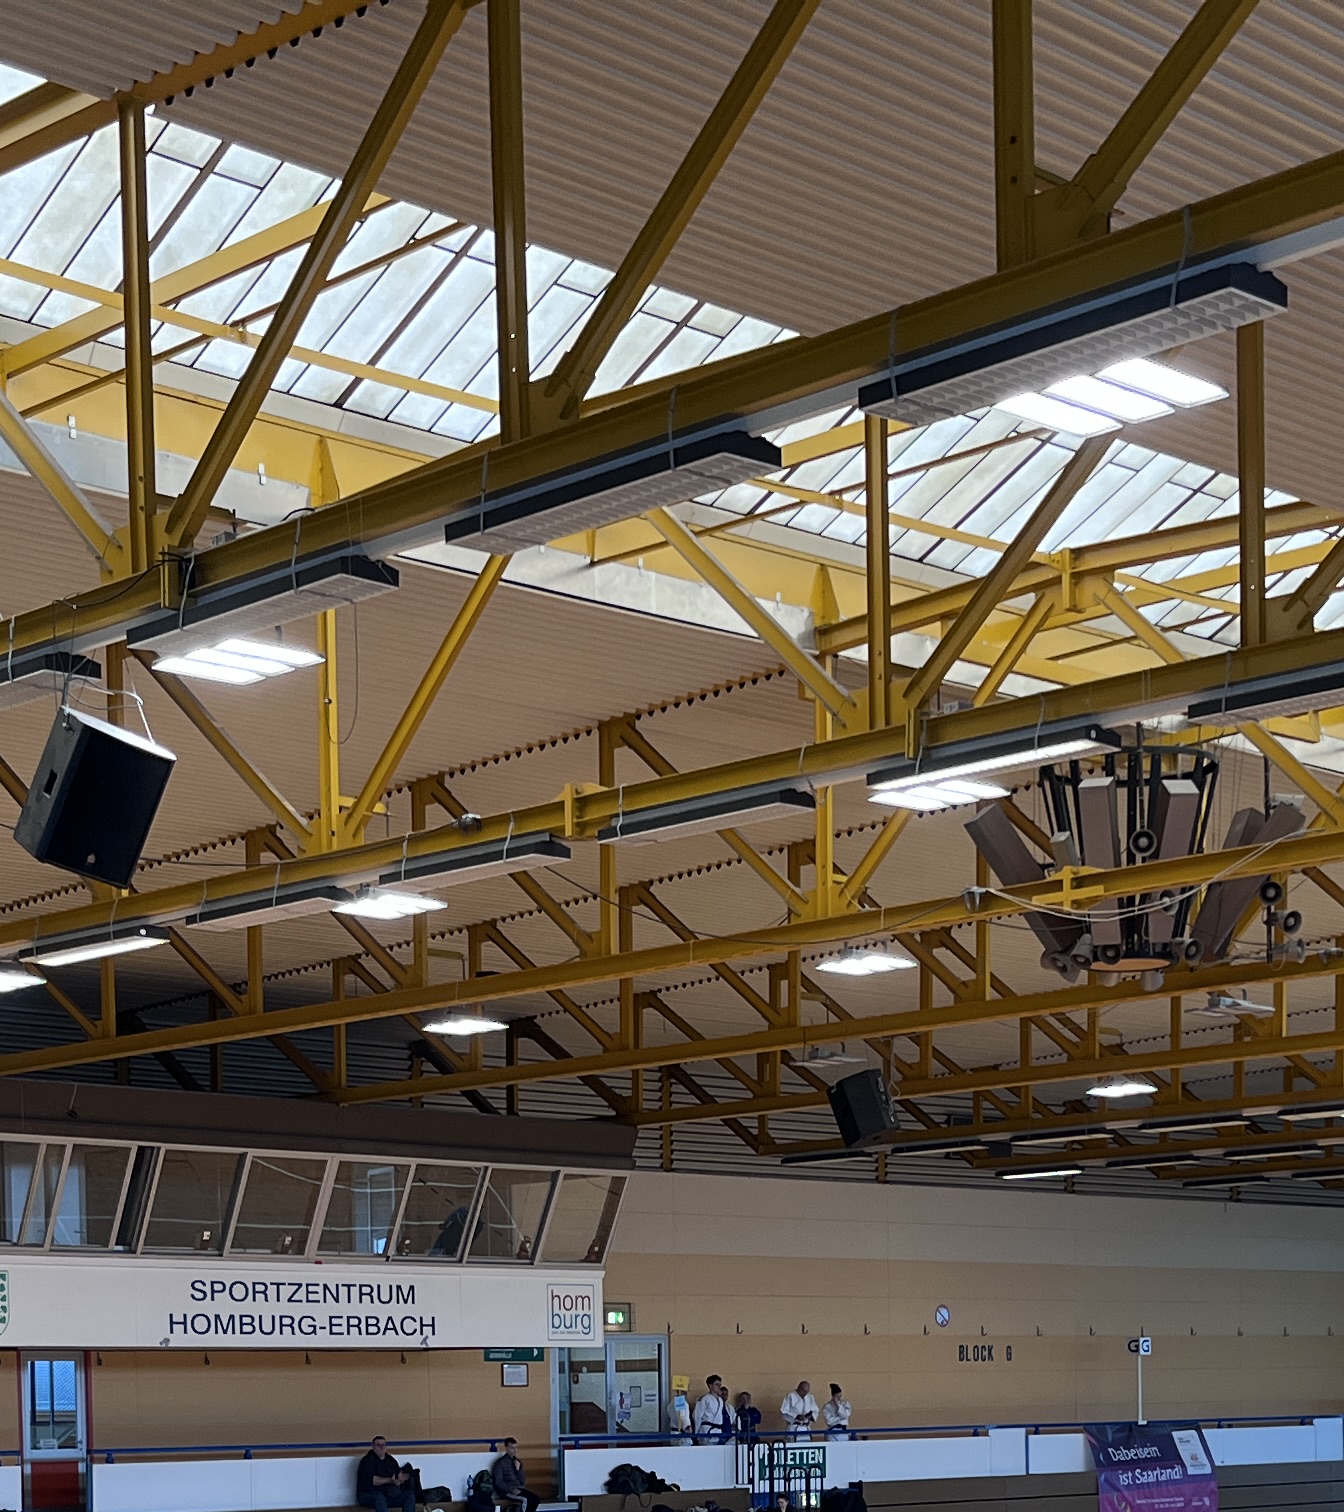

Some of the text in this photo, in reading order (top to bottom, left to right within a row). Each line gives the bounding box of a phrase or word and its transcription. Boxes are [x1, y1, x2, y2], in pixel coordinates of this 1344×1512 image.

[190, 1279, 416, 1305] SPORTZENTRUM
[550, 1289, 591, 1311] hom
[169, 1313, 436, 1337] HOMBURG-ERBACH
[551, 1313, 592, 1335] burg
[958, 1344, 1013, 1362] BLOCK G
[1141, 1339, 1151, 1353] G
[1108, 1443, 1162, 1462] Dabeisein
[1118, 1464, 1184, 1486] ist Saarland!
